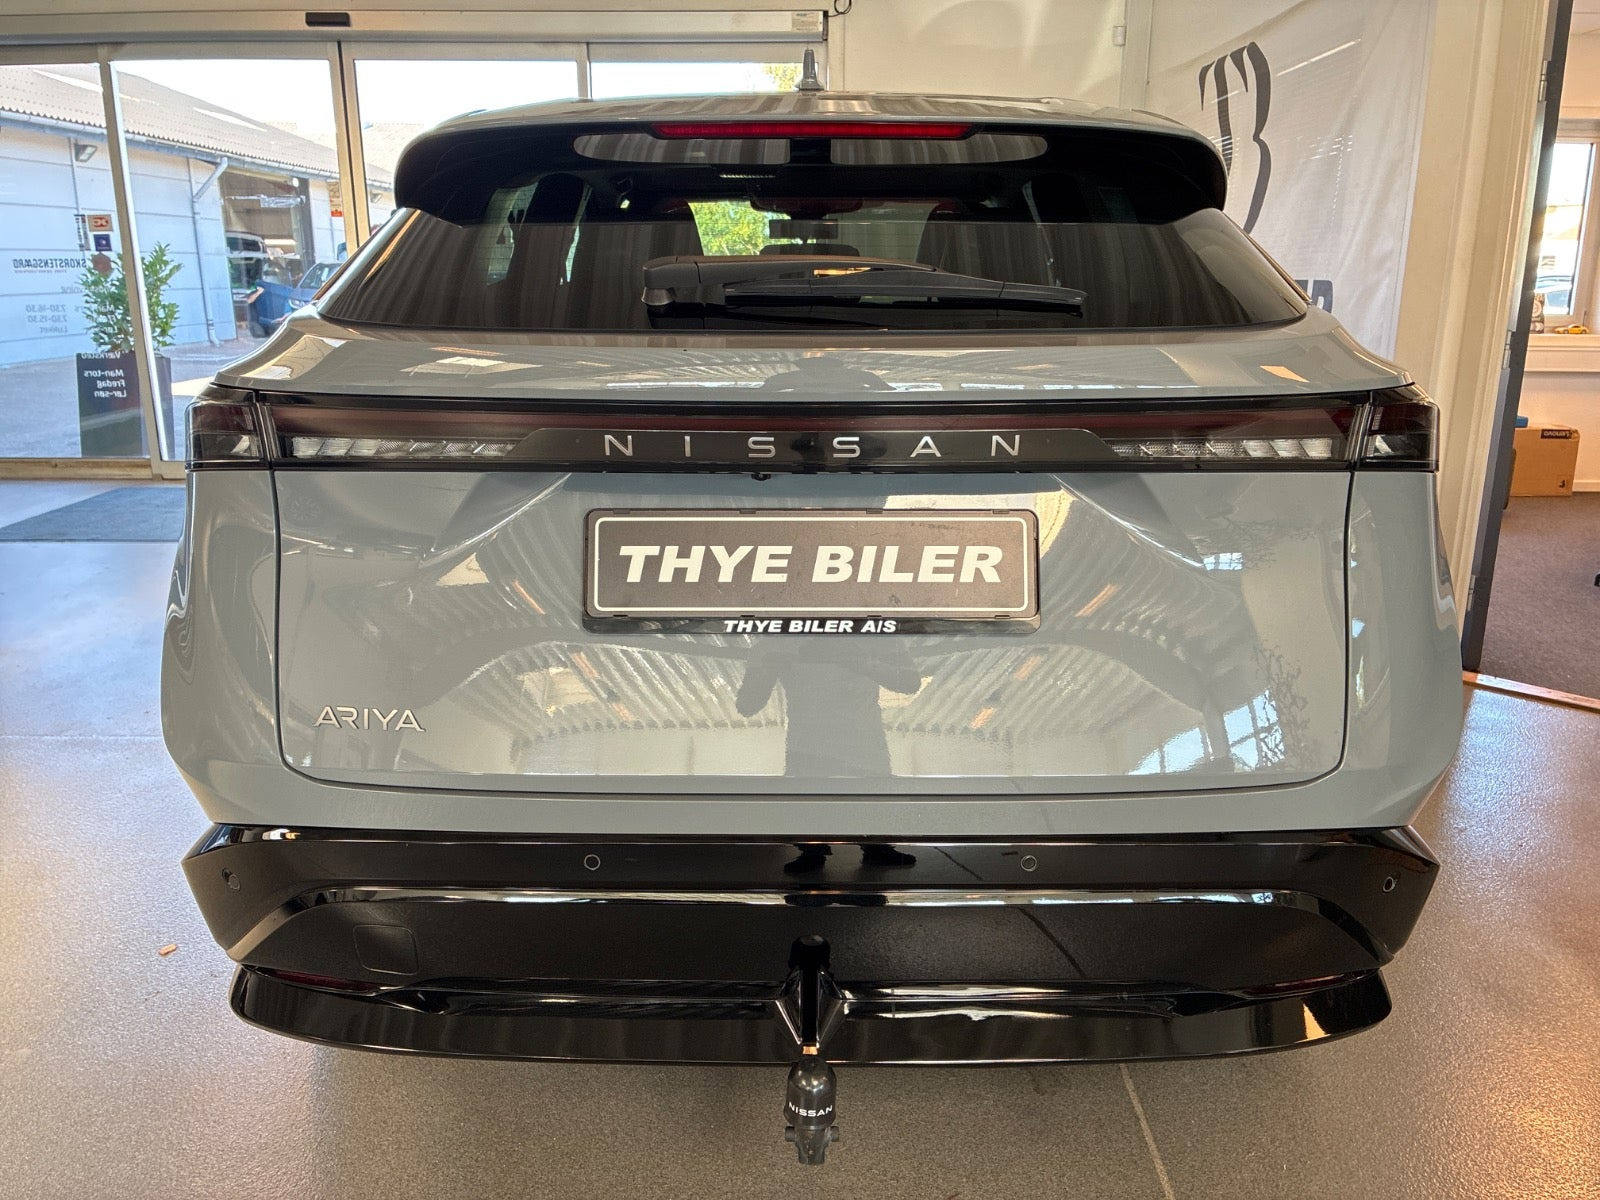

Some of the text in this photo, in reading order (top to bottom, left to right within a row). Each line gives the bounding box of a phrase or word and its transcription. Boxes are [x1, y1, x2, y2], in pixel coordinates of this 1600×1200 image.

[604, 434, 1021, 458] NISSAN
[619, 546, 1002, 583] THYE BILER
[723, 620, 897, 633] THYE BILER A/S
[312, 706, 426, 732] ARIYA
[788, 1101, 833, 1117] NISSAN
